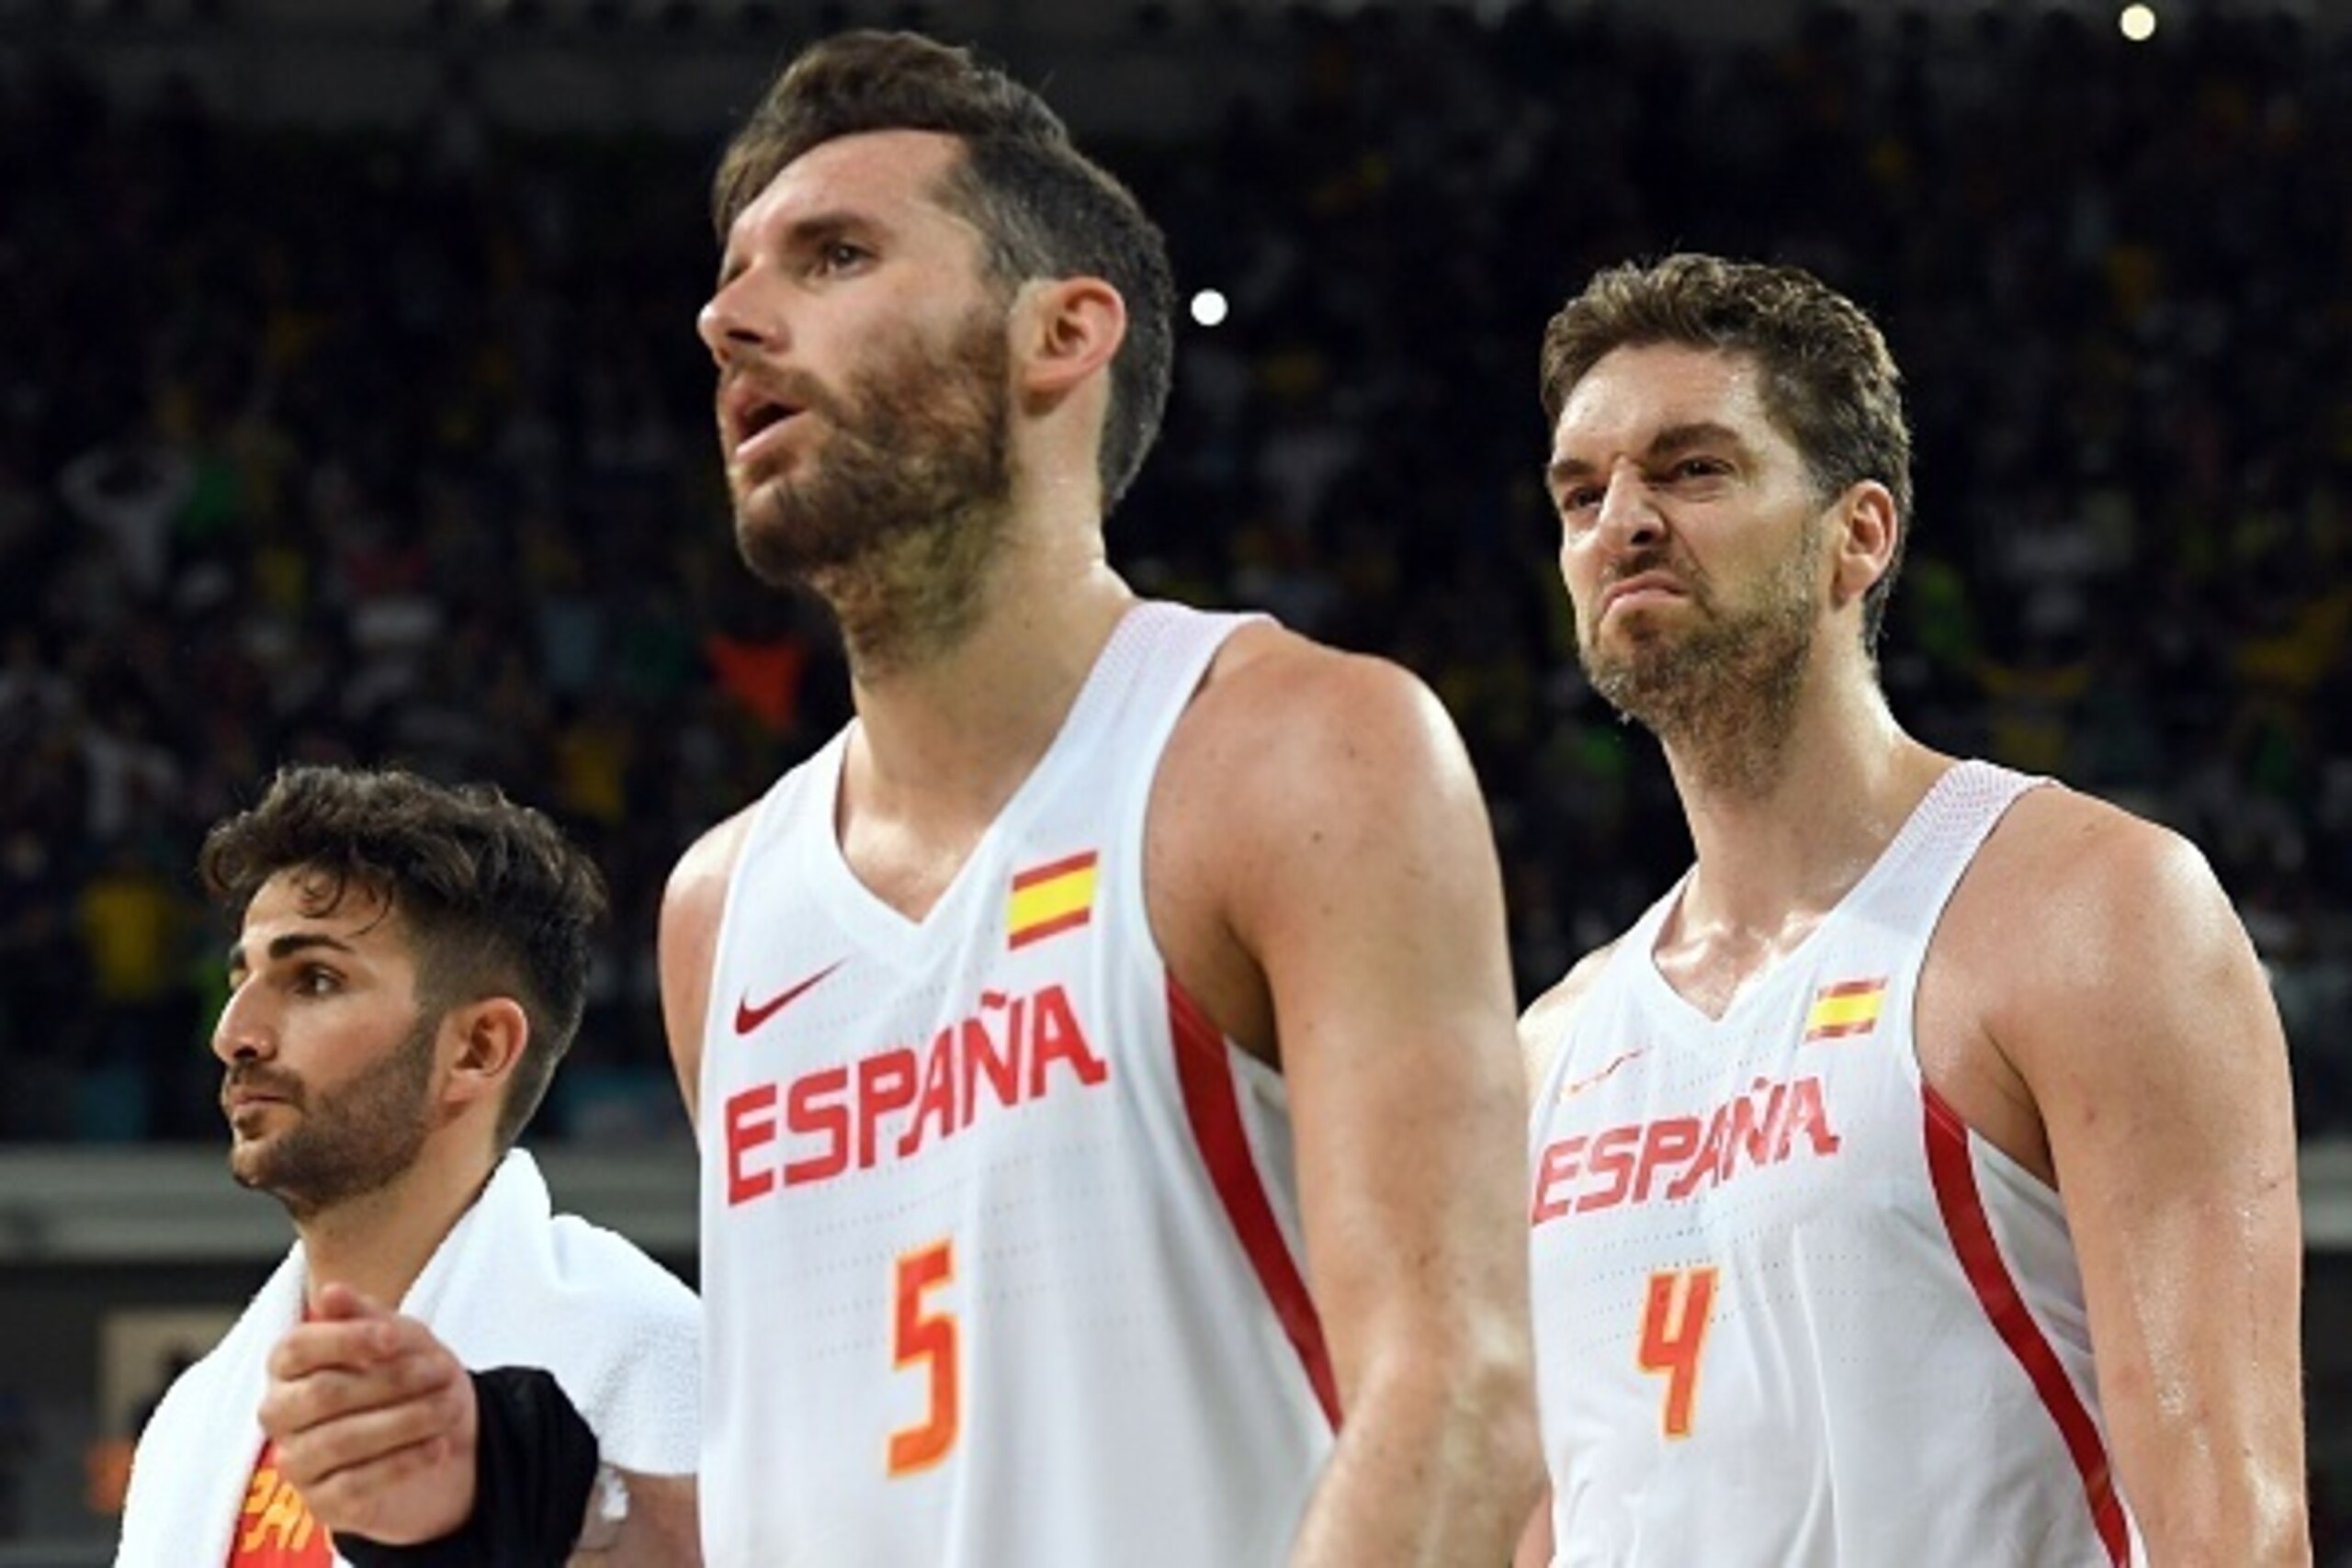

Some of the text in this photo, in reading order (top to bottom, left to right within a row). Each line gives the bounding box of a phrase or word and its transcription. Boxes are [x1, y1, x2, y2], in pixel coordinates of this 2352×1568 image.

[724, 985, 1108, 1207] ESPAÑA
[1532, 1076, 1842, 1228] ESPAÑA
[888, 1236, 959, 1478] 5
[1637, 1266, 1718, 1440] 4
